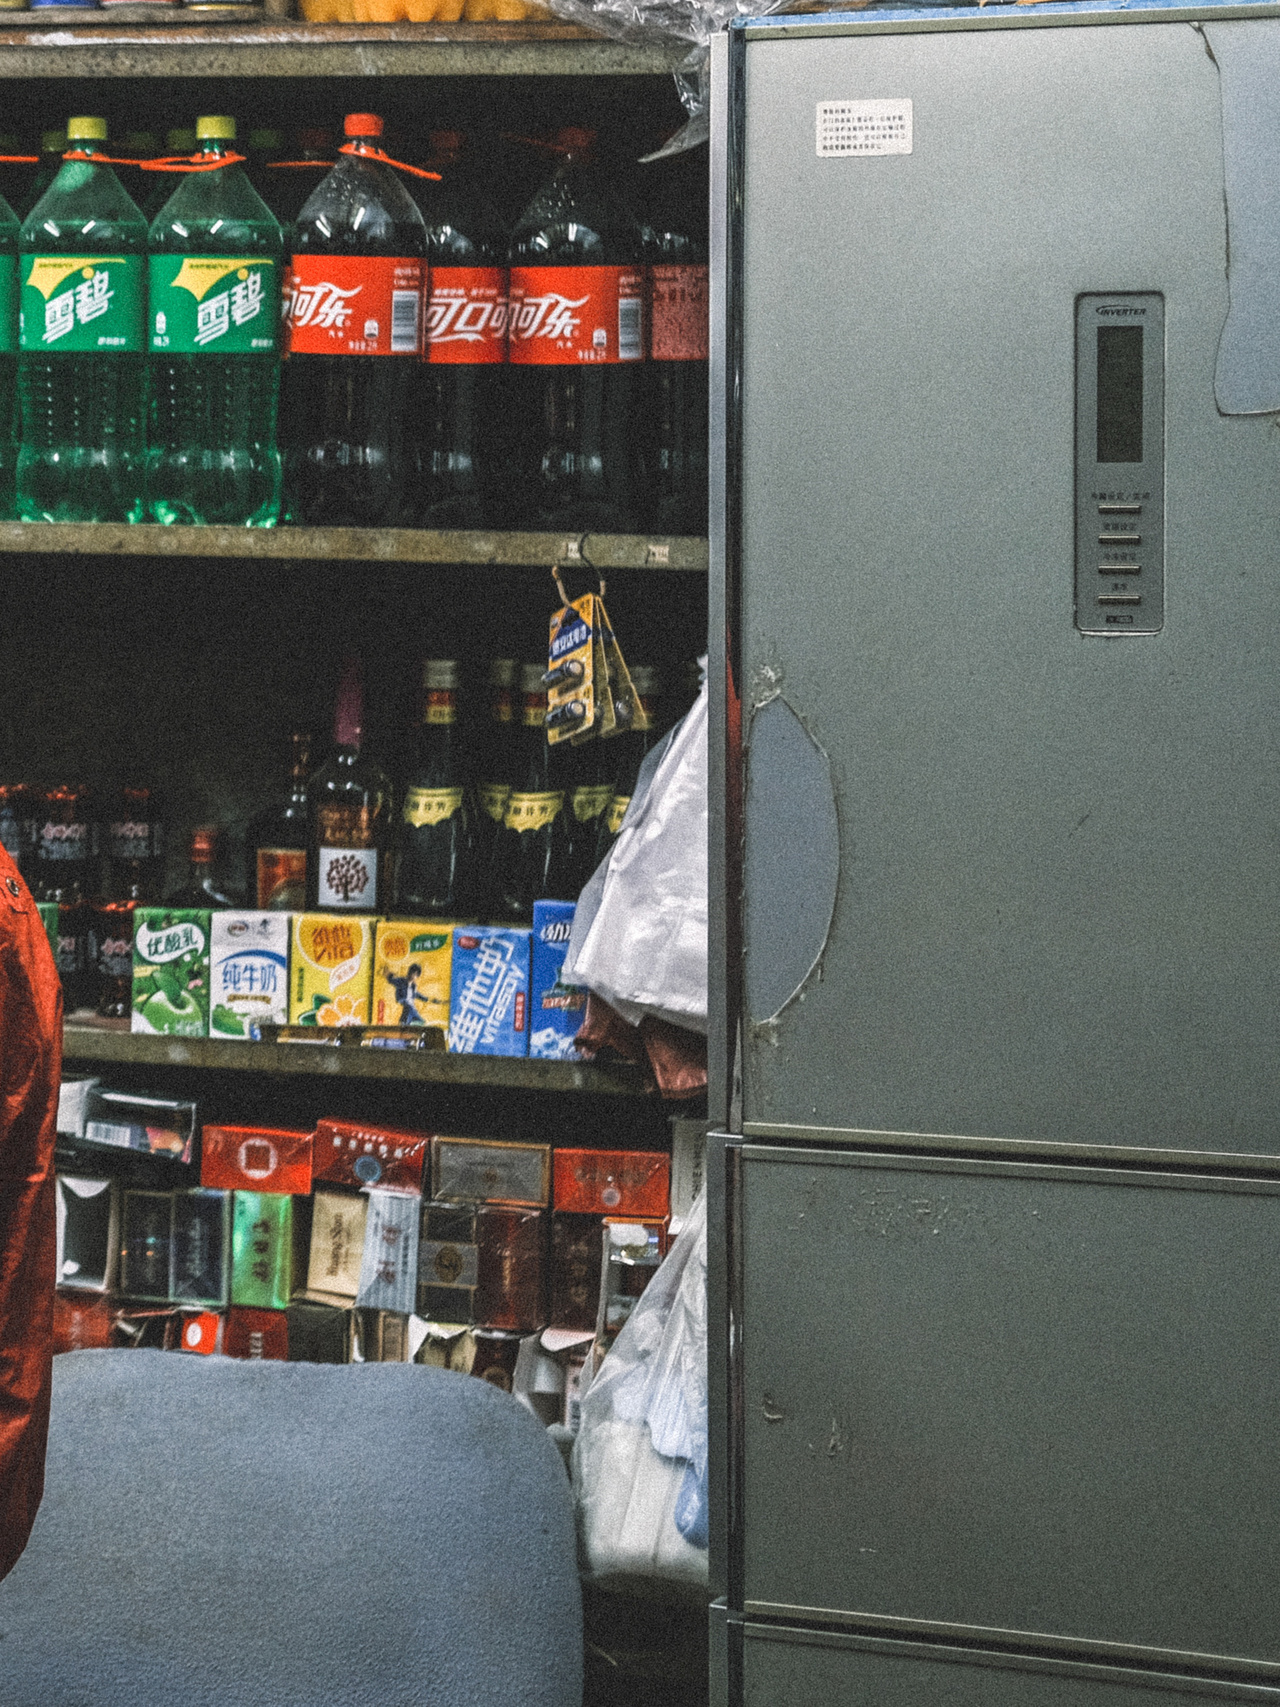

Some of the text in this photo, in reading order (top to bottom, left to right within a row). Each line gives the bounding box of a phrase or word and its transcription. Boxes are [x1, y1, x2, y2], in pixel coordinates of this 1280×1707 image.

[41, 270, 116, 345] 雪碧
[193, 271, 266, 347] 雪碧
[290, 281, 364, 328] 可乐
[1096, 305, 1147, 317] INVERTER
[146, 926, 199, 957] 优酸乳
[221, 961, 278, 993] 纯牛奶
